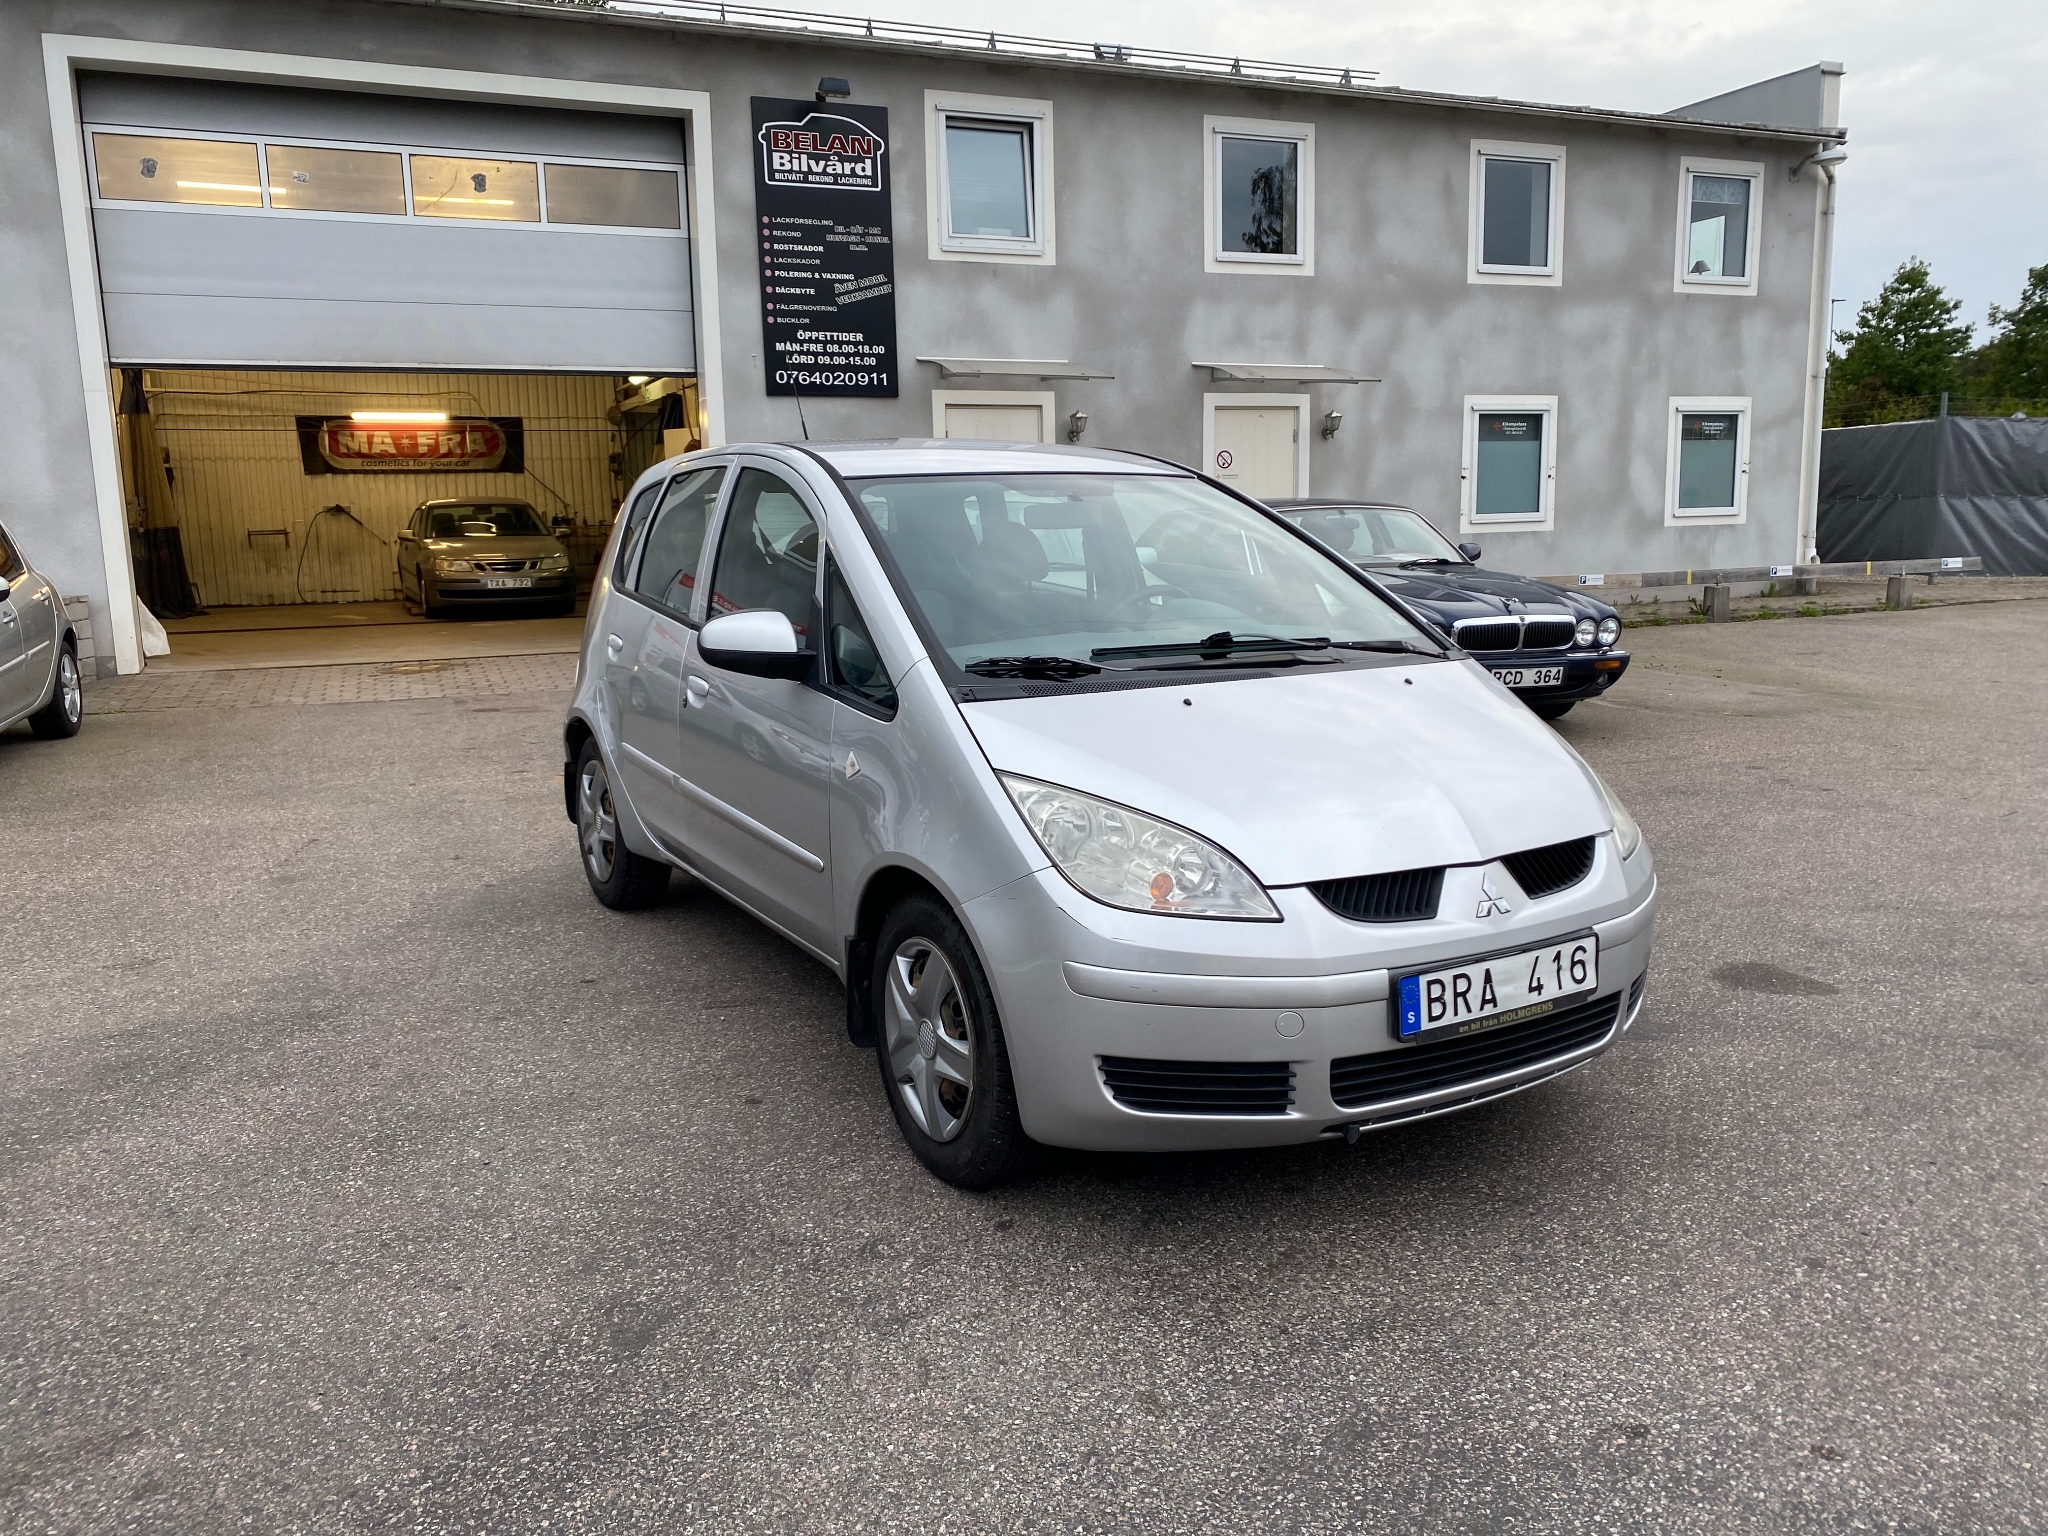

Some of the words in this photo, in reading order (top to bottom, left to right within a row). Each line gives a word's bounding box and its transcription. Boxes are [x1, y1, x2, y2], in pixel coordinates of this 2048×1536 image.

[770, 128, 874, 157] BELAN
[772, 151, 872, 176] Bilvård
[774, 172, 805, 181] BILTVÄTT
[808, 174, 834, 183] REKOND
[837, 176, 872, 185] LACKERING
[772, 230, 802, 238] REKOND
[773, 243, 824, 252] ROSTSKADOR
[773, 257, 821, 265] LACKSKADOR
[774, 270, 813, 278] POLERING
[821, 272, 855, 280] VAXNING
[775, 285, 816, 295] DÄCKBYTE
[833, 280, 859, 294] ÄVEN
[858, 273, 888, 288] MOBIL
[835, 283, 892, 305] VERKSAMHET
[796, 329, 864, 342] ÖPPETTIDER
[775, 340, 824, 353] MÅN-FRE
[826, 343, 885, 354] 08.00-18.00
[785, 353, 815, 364] LÖRD
[817, 355, 876, 366] 09.00-15.00
[775, 370, 888, 386] 0764020911
[360, 458, 410, 467] cosmetics
[412, 458, 427, 467] for
[428, 459, 453, 469] your
[455, 459, 471, 467] car
[1533, 668, 1561, 684] 364
[1407, 1011, 1416, 1024] S
[1426, 967, 1499, 1023] BRA
[1528, 944, 1588, 997] 416
[1471, 1022, 1481, 1030] bil
[1482, 1018, 1498, 1027] från
[1500, 1001, 1554, 1023] HOLMGRENS
